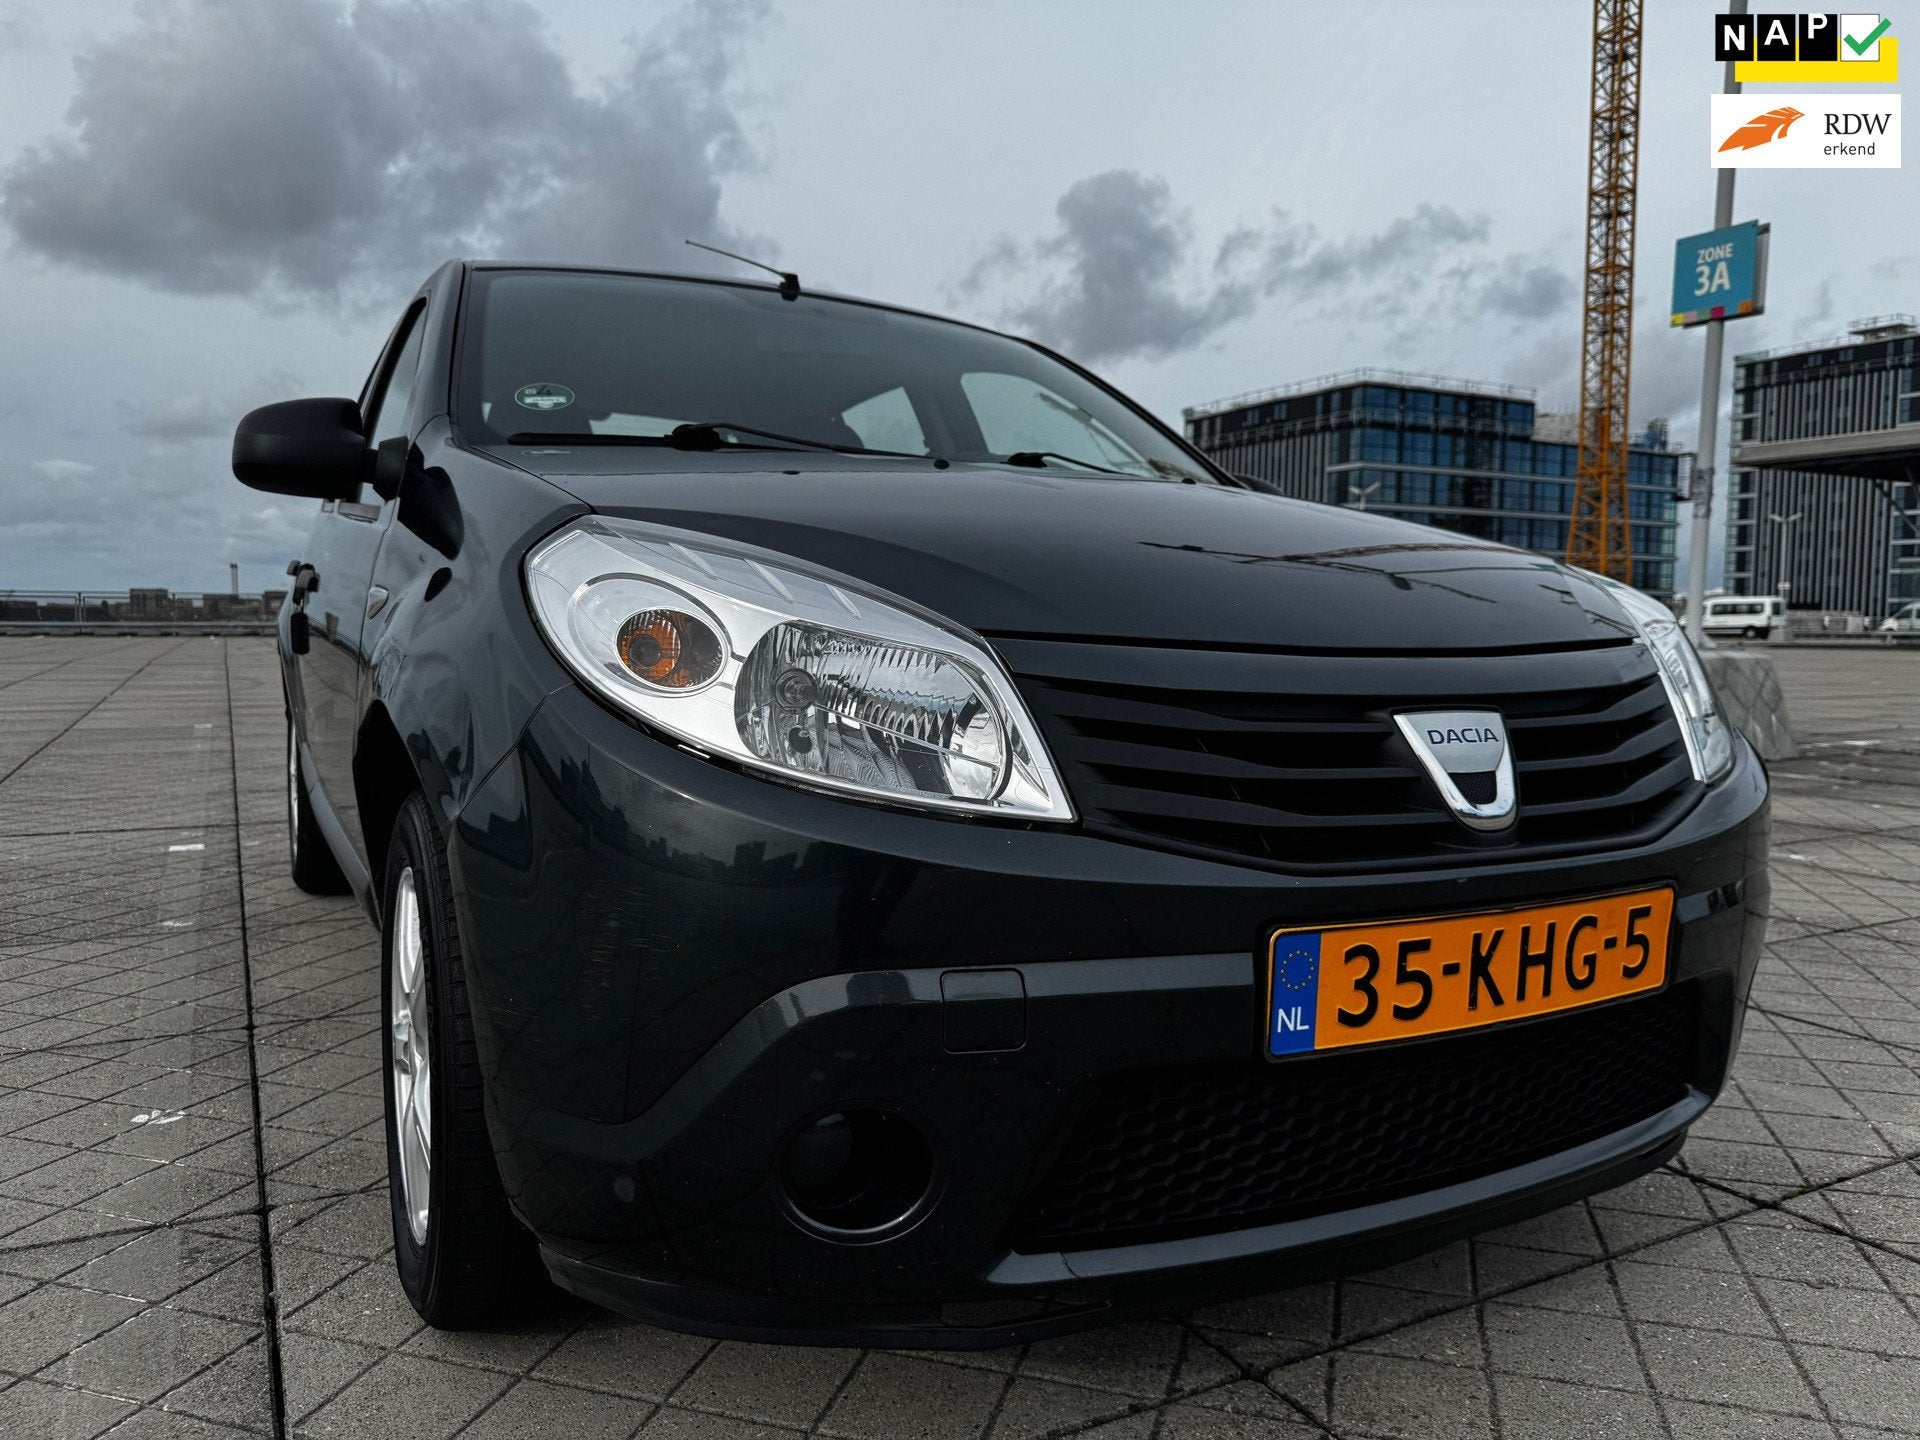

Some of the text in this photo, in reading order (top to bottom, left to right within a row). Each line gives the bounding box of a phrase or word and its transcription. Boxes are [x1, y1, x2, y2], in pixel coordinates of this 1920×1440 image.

[1697, 242, 1734, 264] ZONE
[1694, 261, 1731, 296] 3A
[1427, 728, 1499, 745] DACIA
[1336, 905, 1652, 1028] 35-KHG-5
[1276, 1006, 1309, 1033] NL
